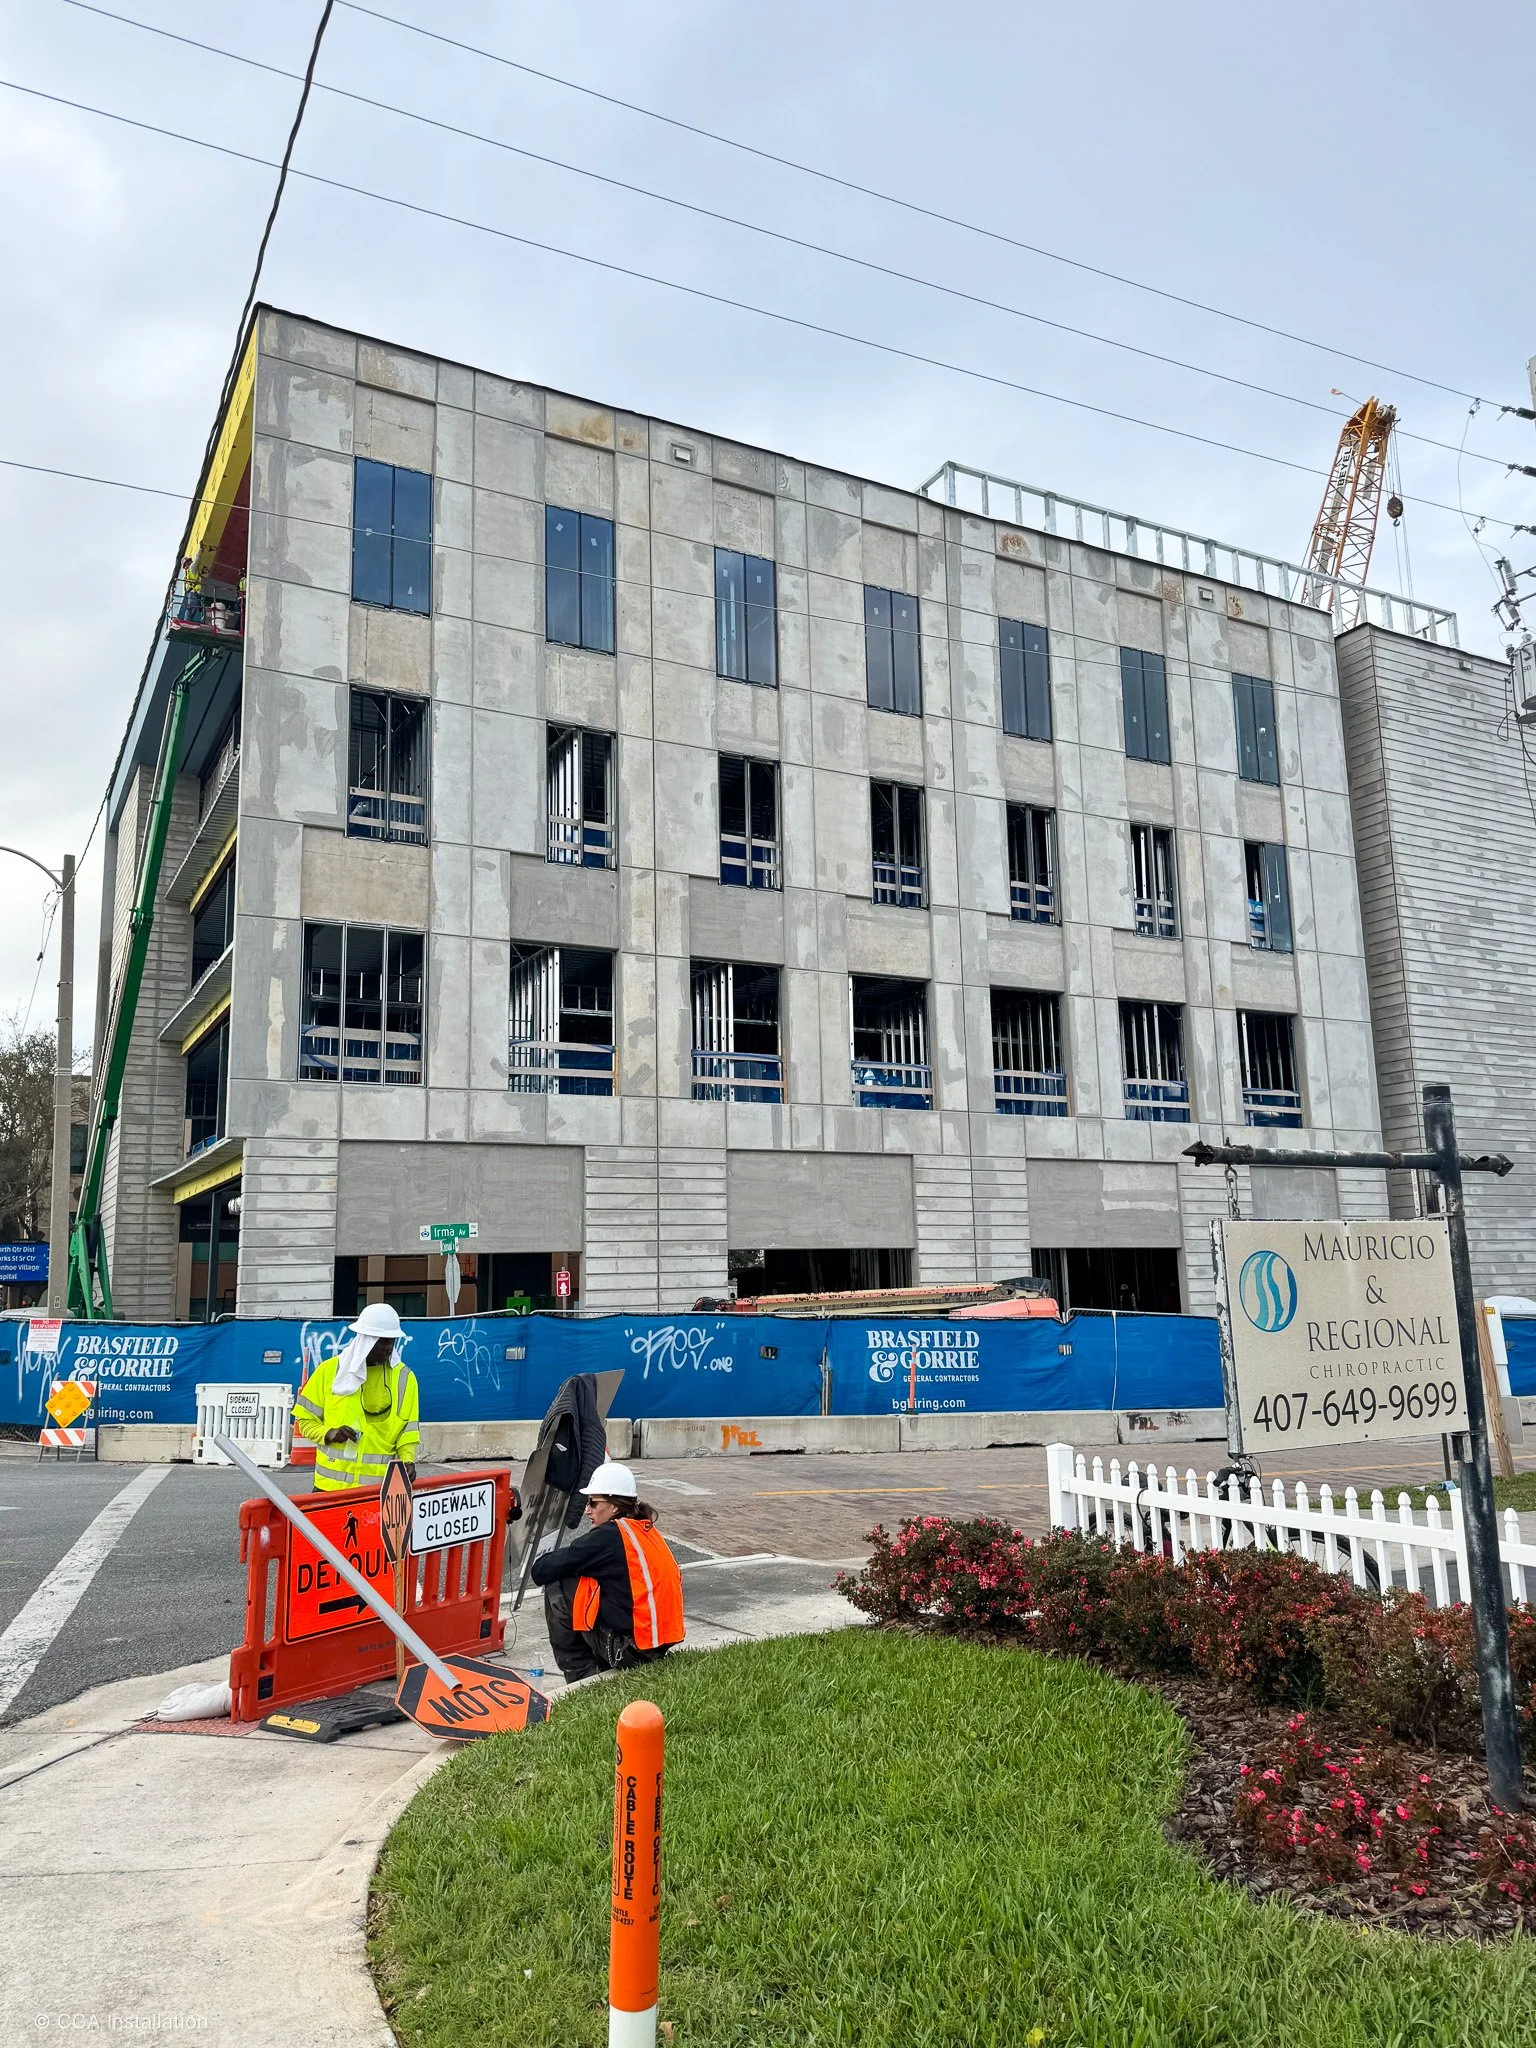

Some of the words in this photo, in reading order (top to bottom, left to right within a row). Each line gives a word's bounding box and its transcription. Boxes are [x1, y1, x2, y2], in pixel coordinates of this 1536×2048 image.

[1337, 447, 1352, 487] BEYEL
[434, 1227, 455, 1238] Irma
[458, 1228, 466, 1236] Av
[1304, 1232, 1435, 1261] MAURICIO
[17, 1264, 40, 1272] Village
[1366, 1275, 1388, 1304] &
[74, 1335, 180, 1356] BRASFIELD
[865, 1330, 980, 1349] BRASFIELD
[1307, 1316, 1450, 1352] REGIONAL
[97, 1357, 174, 1378] GORRIE
[868, 1351, 899, 1383] &
[900, 1350, 980, 1370] GORRIE
[1309, 1357, 1446, 1380] CHIROPRACTIC
[124, 1384, 171, 1392] CONTRACTORS
[229, 1395, 257, 1404] SIDEWALK
[231, 1405, 253, 1414] CLOSED
[1253, 1380, 1458, 1433] 407-649-9699
[385, 1493, 407, 1530] SLOW
[418, 1490, 487, 1519] SIDEWALK
[426, 1515, 479, 1542] CLOSED
[427, 1679, 525, 1725] SLOW
[626, 1775, 637, 1836] CABLE
[623, 1839, 635, 1901] ROUTE
